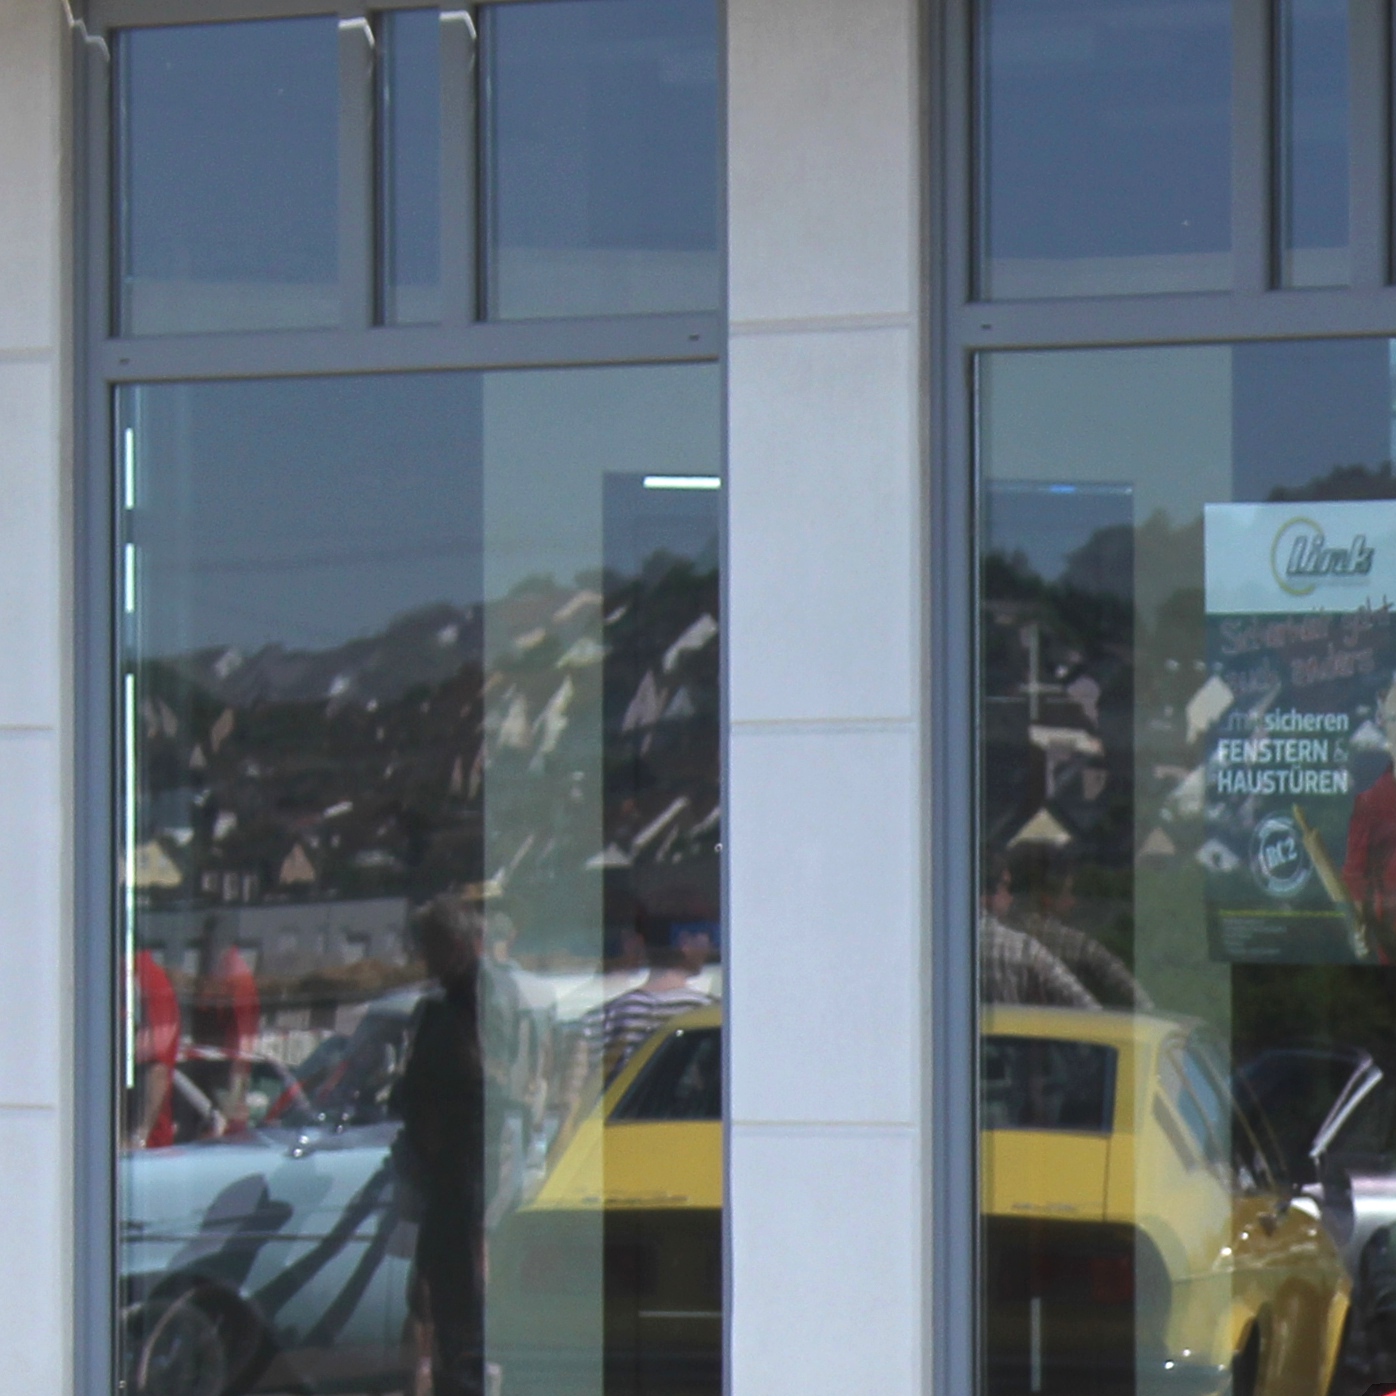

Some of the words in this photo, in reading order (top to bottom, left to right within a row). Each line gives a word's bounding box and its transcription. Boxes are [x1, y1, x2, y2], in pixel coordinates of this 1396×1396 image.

[1264, 707, 1349, 732] sicheren
[1217, 737, 1328, 763] FENSTERN
[1217, 763, 1349, 795] HAUSTÜREN
